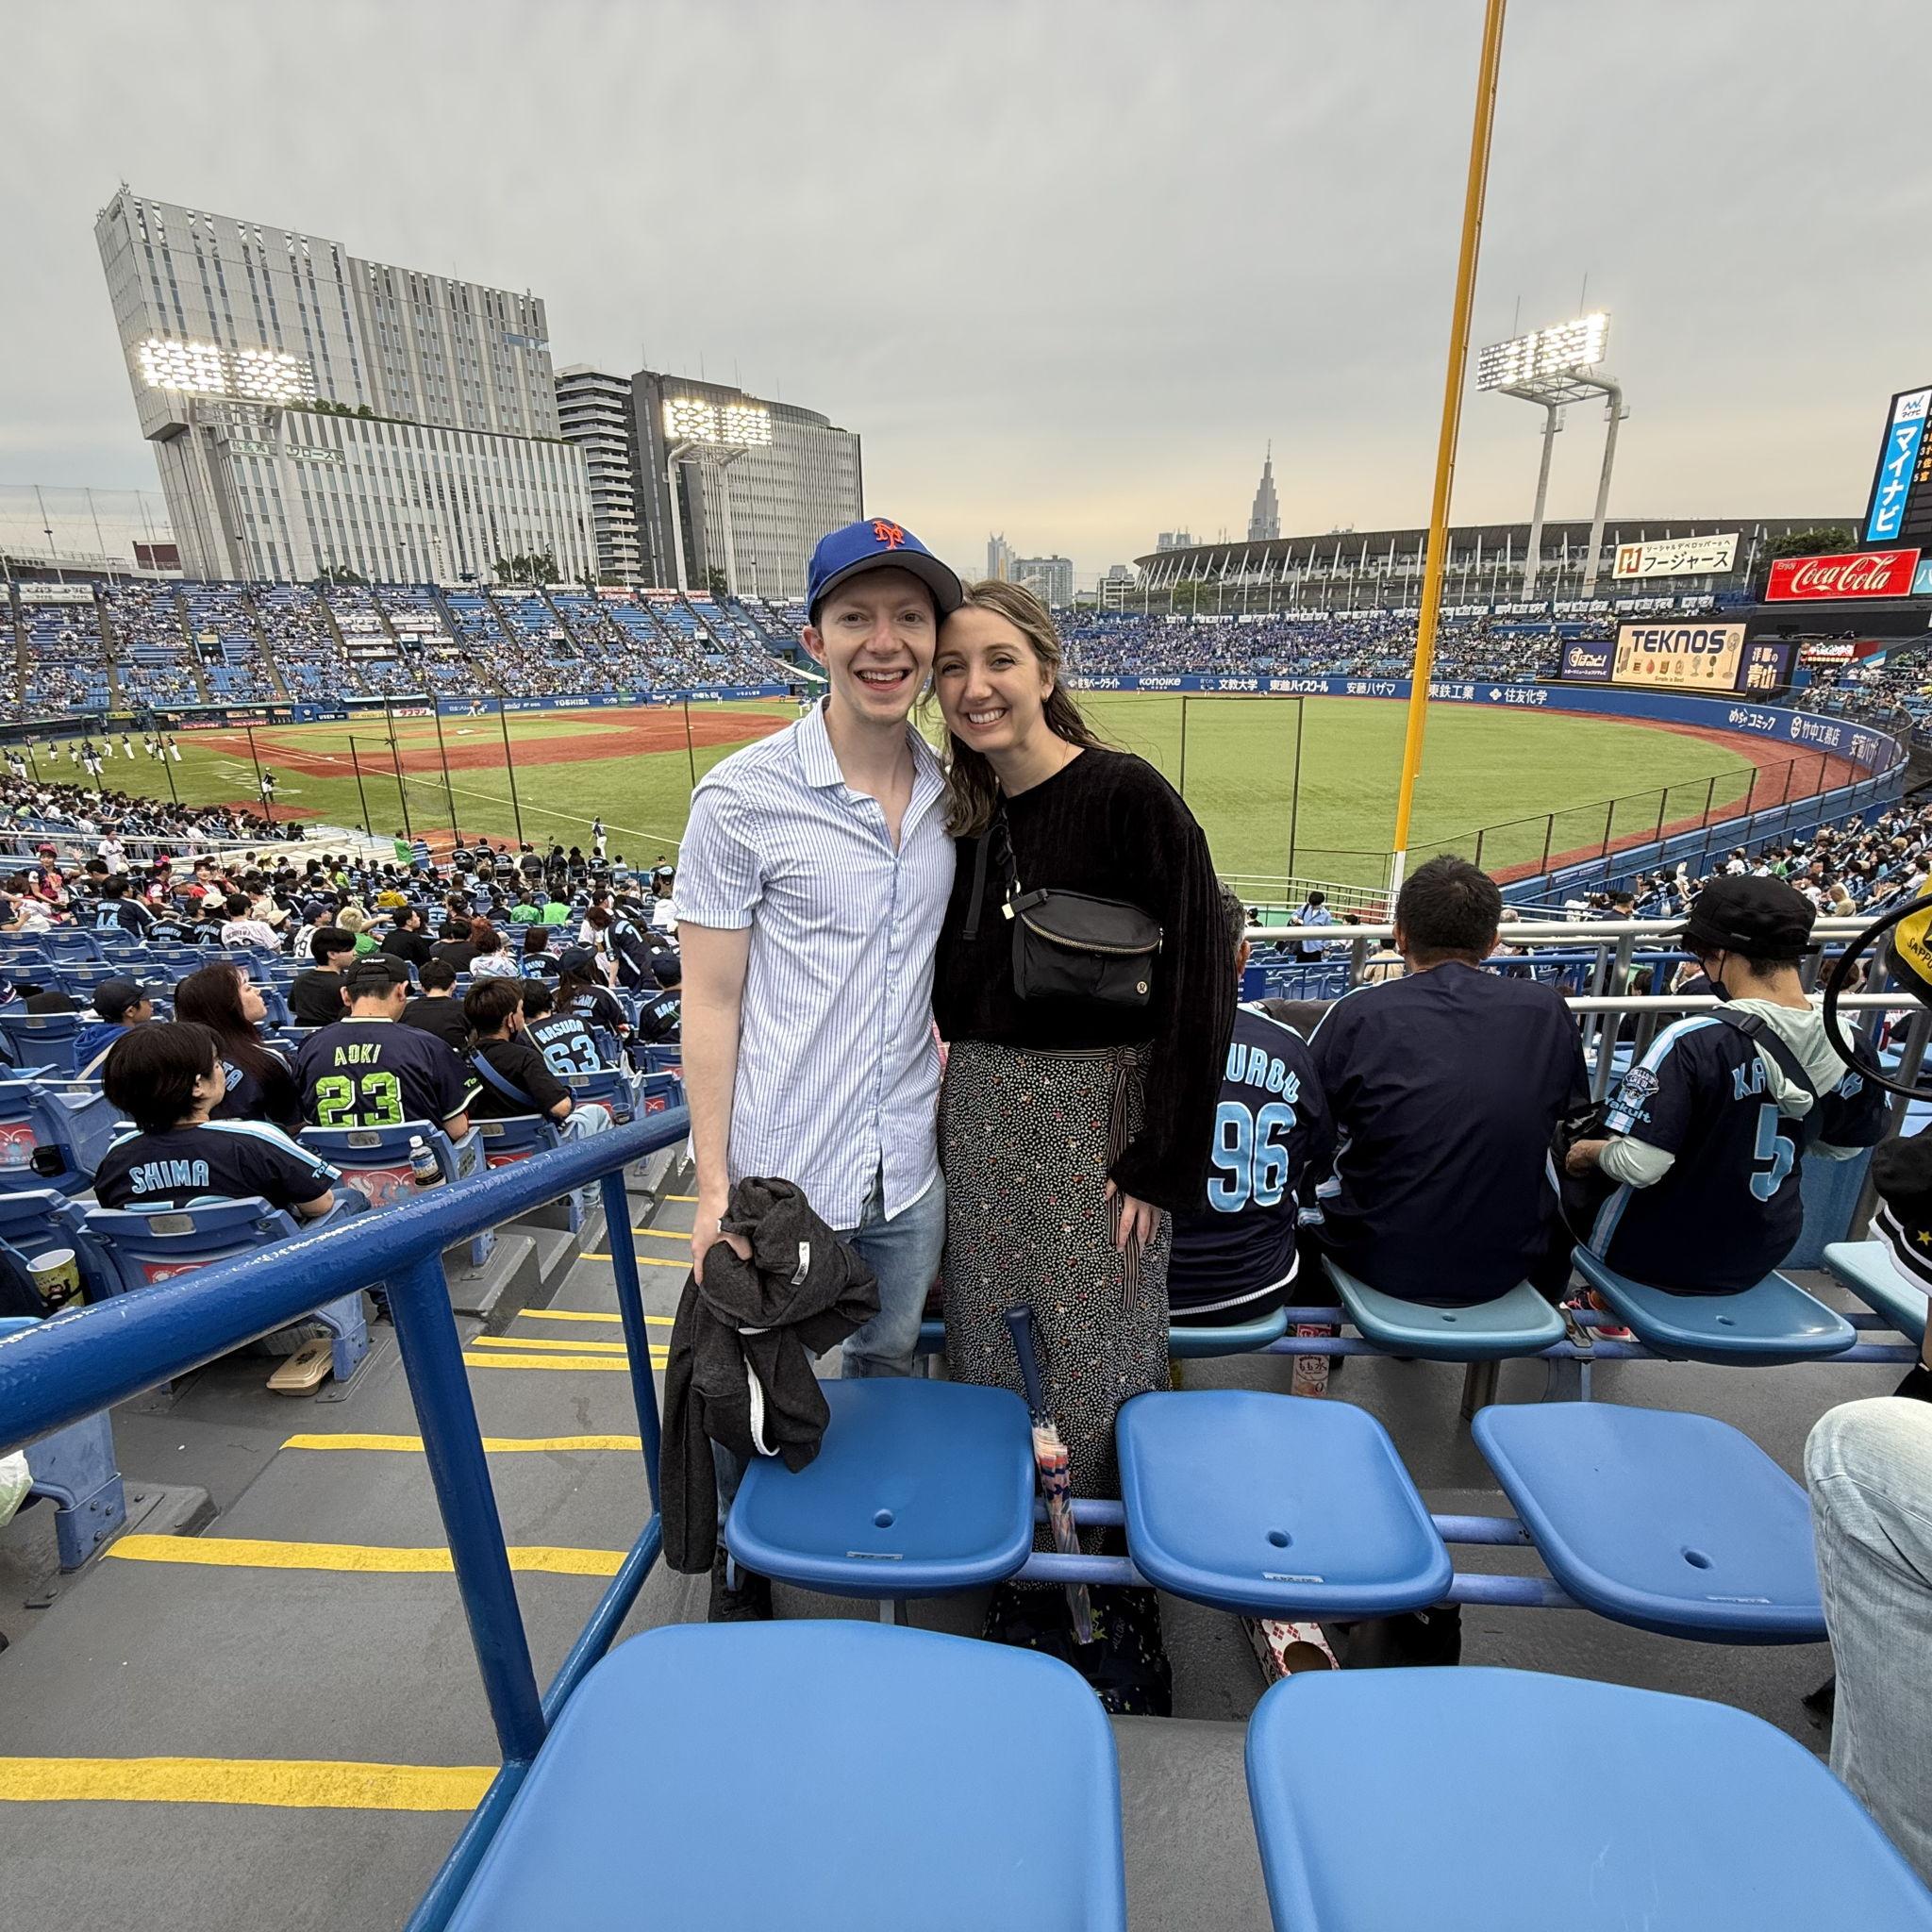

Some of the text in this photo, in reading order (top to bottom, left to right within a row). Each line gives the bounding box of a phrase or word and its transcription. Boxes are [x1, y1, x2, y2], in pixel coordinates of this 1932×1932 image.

[1876, 426, 1918, 531] マイナビ
[1644, 551, 1728, 573] フージャース
[1790, 554, 1900, 593] Coca-Cola
[1632, 629, 1726, 654] TEKNOS
[1218, 678, 1258, 691] 文教大学
[1269, 679, 1329, 693] 東進ハイスクール
[1346, 681, 1396, 696] 安藤ハザマ
[1747, 663, 1777, 690] 青山
[554, 698, 590, 707] TOSHIBA
[1427, 684, 1475, 701] 東鉄工業
[1504, 688, 1548, 706] 住友化学
[1728, 708, 1776, 731] めちゃコミック
[1802, 720, 1841, 747] 竹中工務店
[535, 1019, 585, 1044] MASUDA
[334, 1043, 382, 1067] AOKI
[543, 1035, 601, 1075] 63
[315, 1071, 406, 1128] 23
[1604, 1096, 1652, 1124] Yakult
[1207, 1101, 1297, 1213] 96
[1749, 1102, 1804, 1203] 5
[128, 1158, 209, 1194] SHIMA
